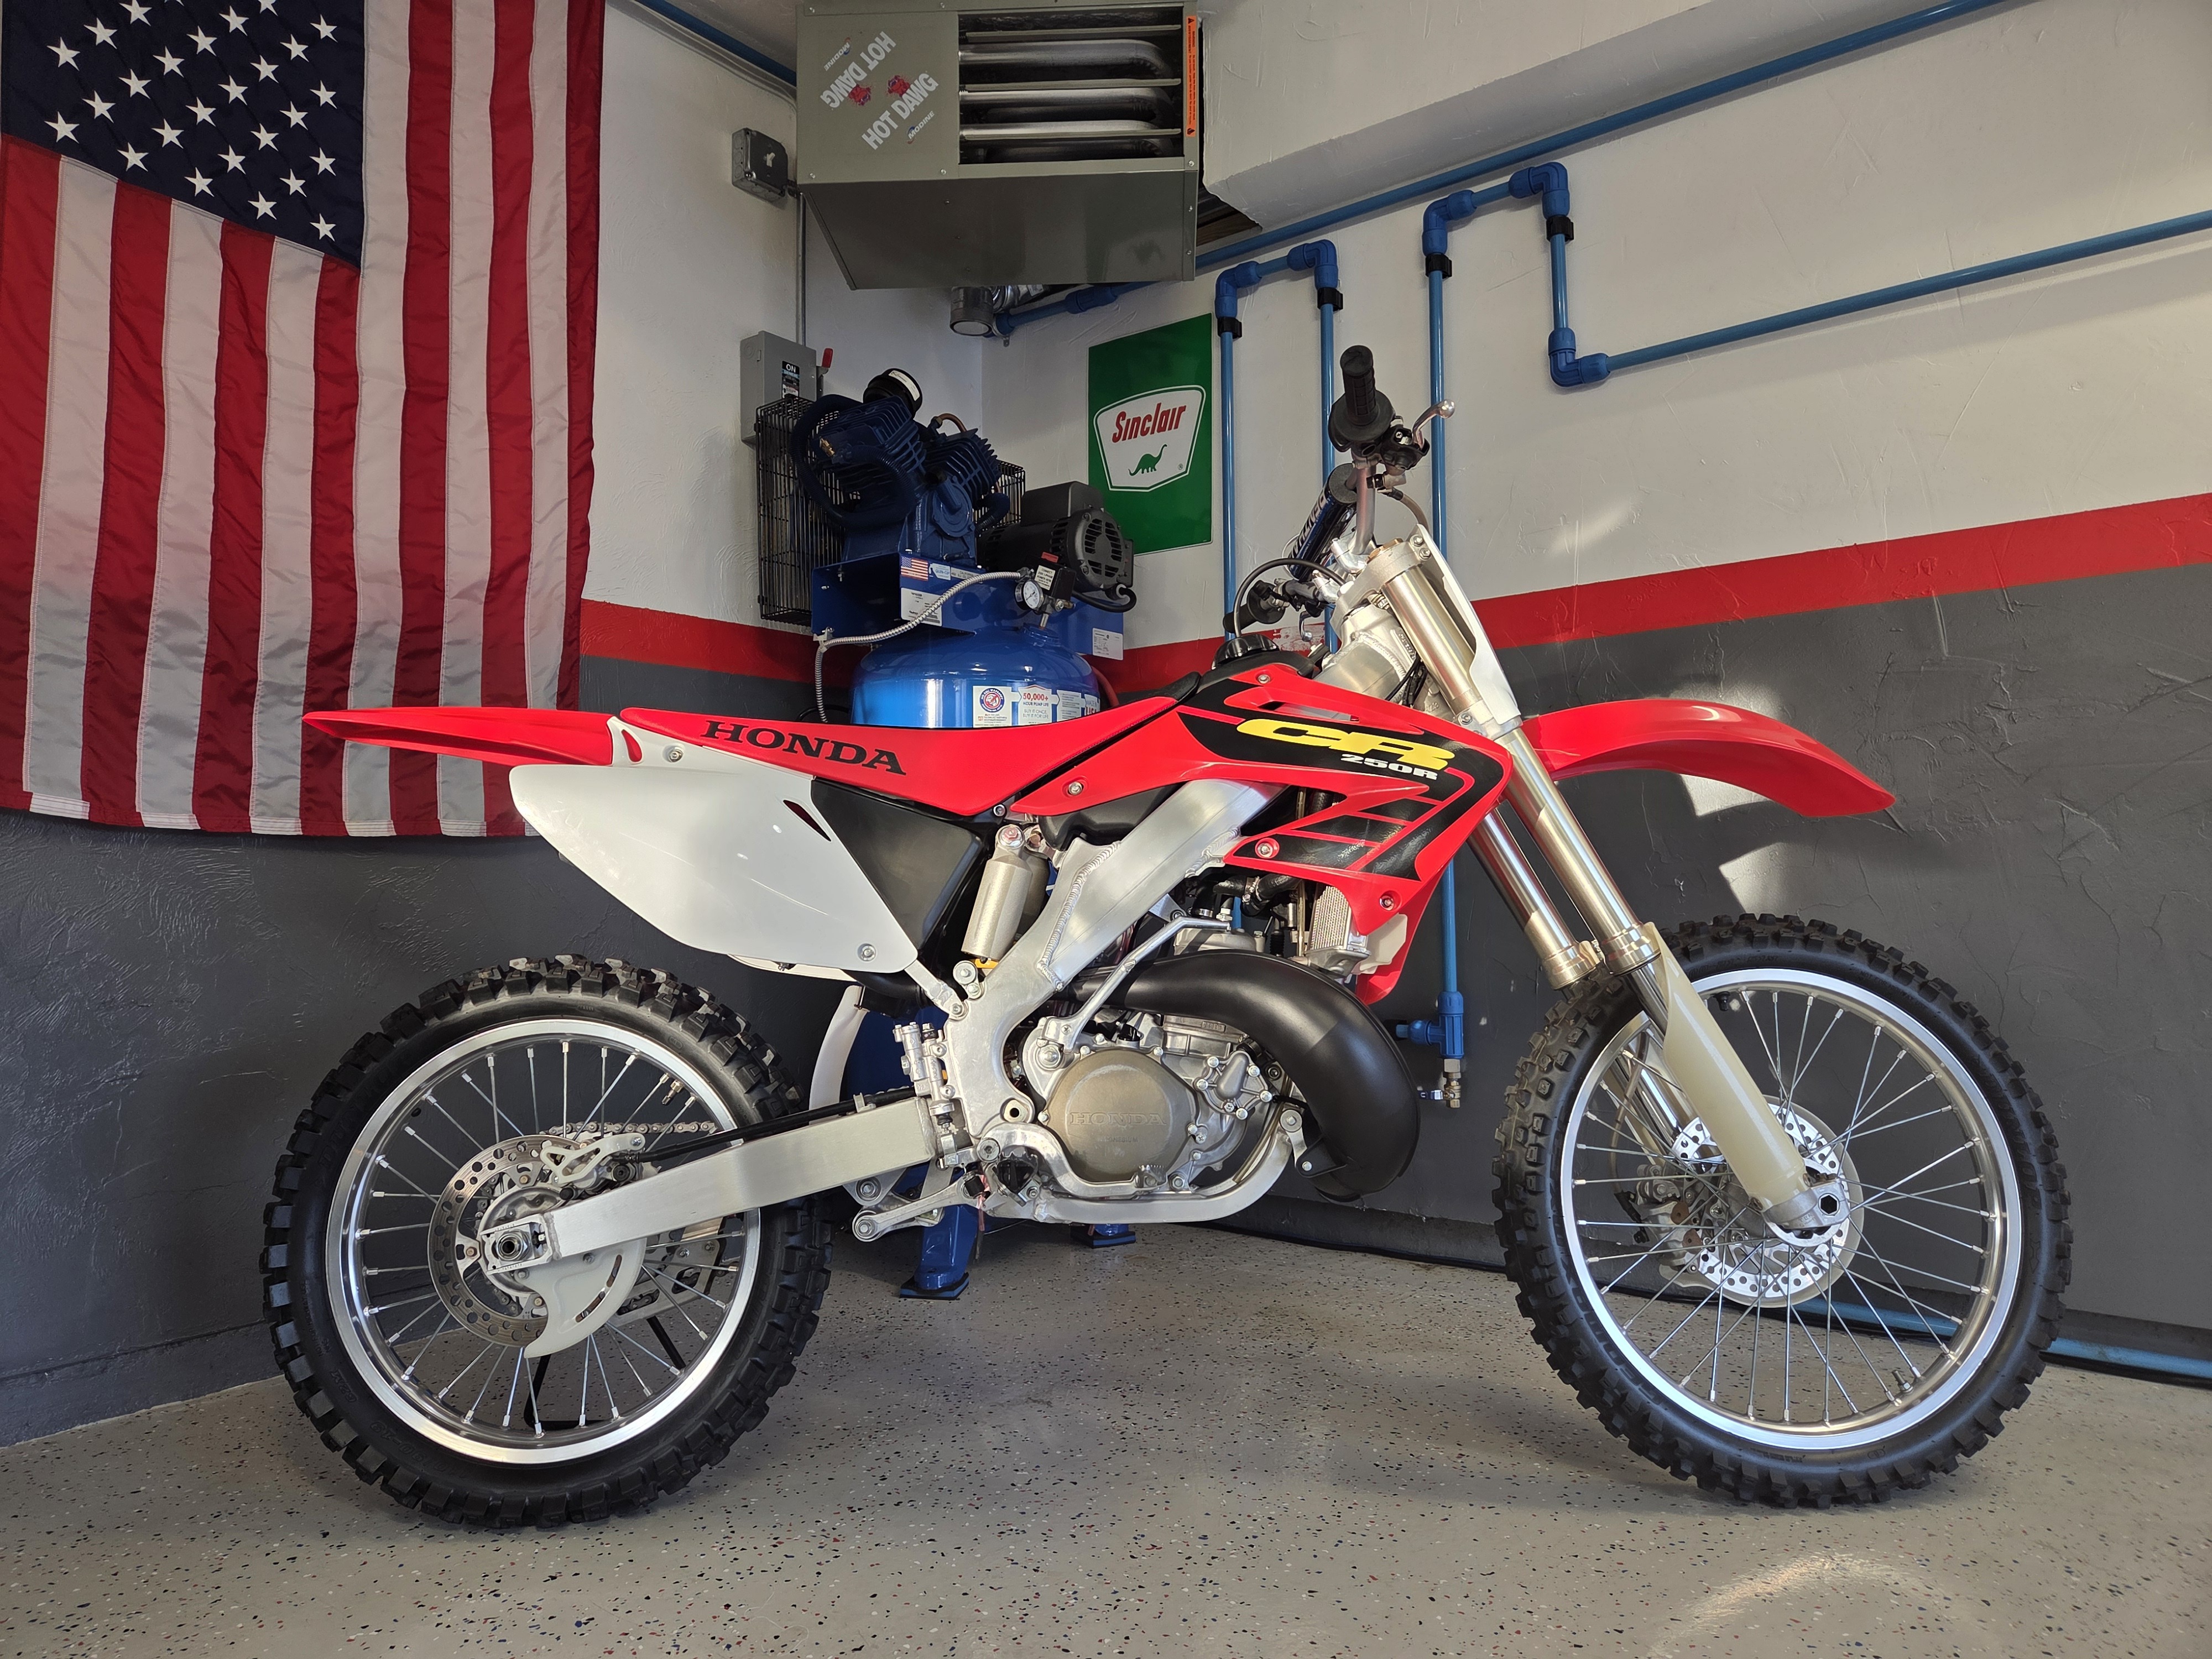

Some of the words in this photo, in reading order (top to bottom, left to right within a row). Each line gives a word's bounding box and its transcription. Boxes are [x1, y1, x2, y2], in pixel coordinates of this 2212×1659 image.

[823, 42, 851, 71] MODINE
[860, 31, 896, 71] HOT
[820, 61, 867, 108] DAWG
[862, 110, 898, 150] HOT
[891, 73, 938, 119] DAWG
[907, 111, 935, 139] MODINE
[786, 363, 796, 373] ON
[1112, 402, 1187, 443] Sinclair
[1023, 692, 1048, 701] 50,000+
[701, 720, 906, 775] HONDA
[1237, 719, 1455, 771] CR
[1340, 754, 1437, 780] 250R
[1070, 1112, 1167, 1126] HONDA
[1560, 1255, 1665, 1407] GEOMAX
